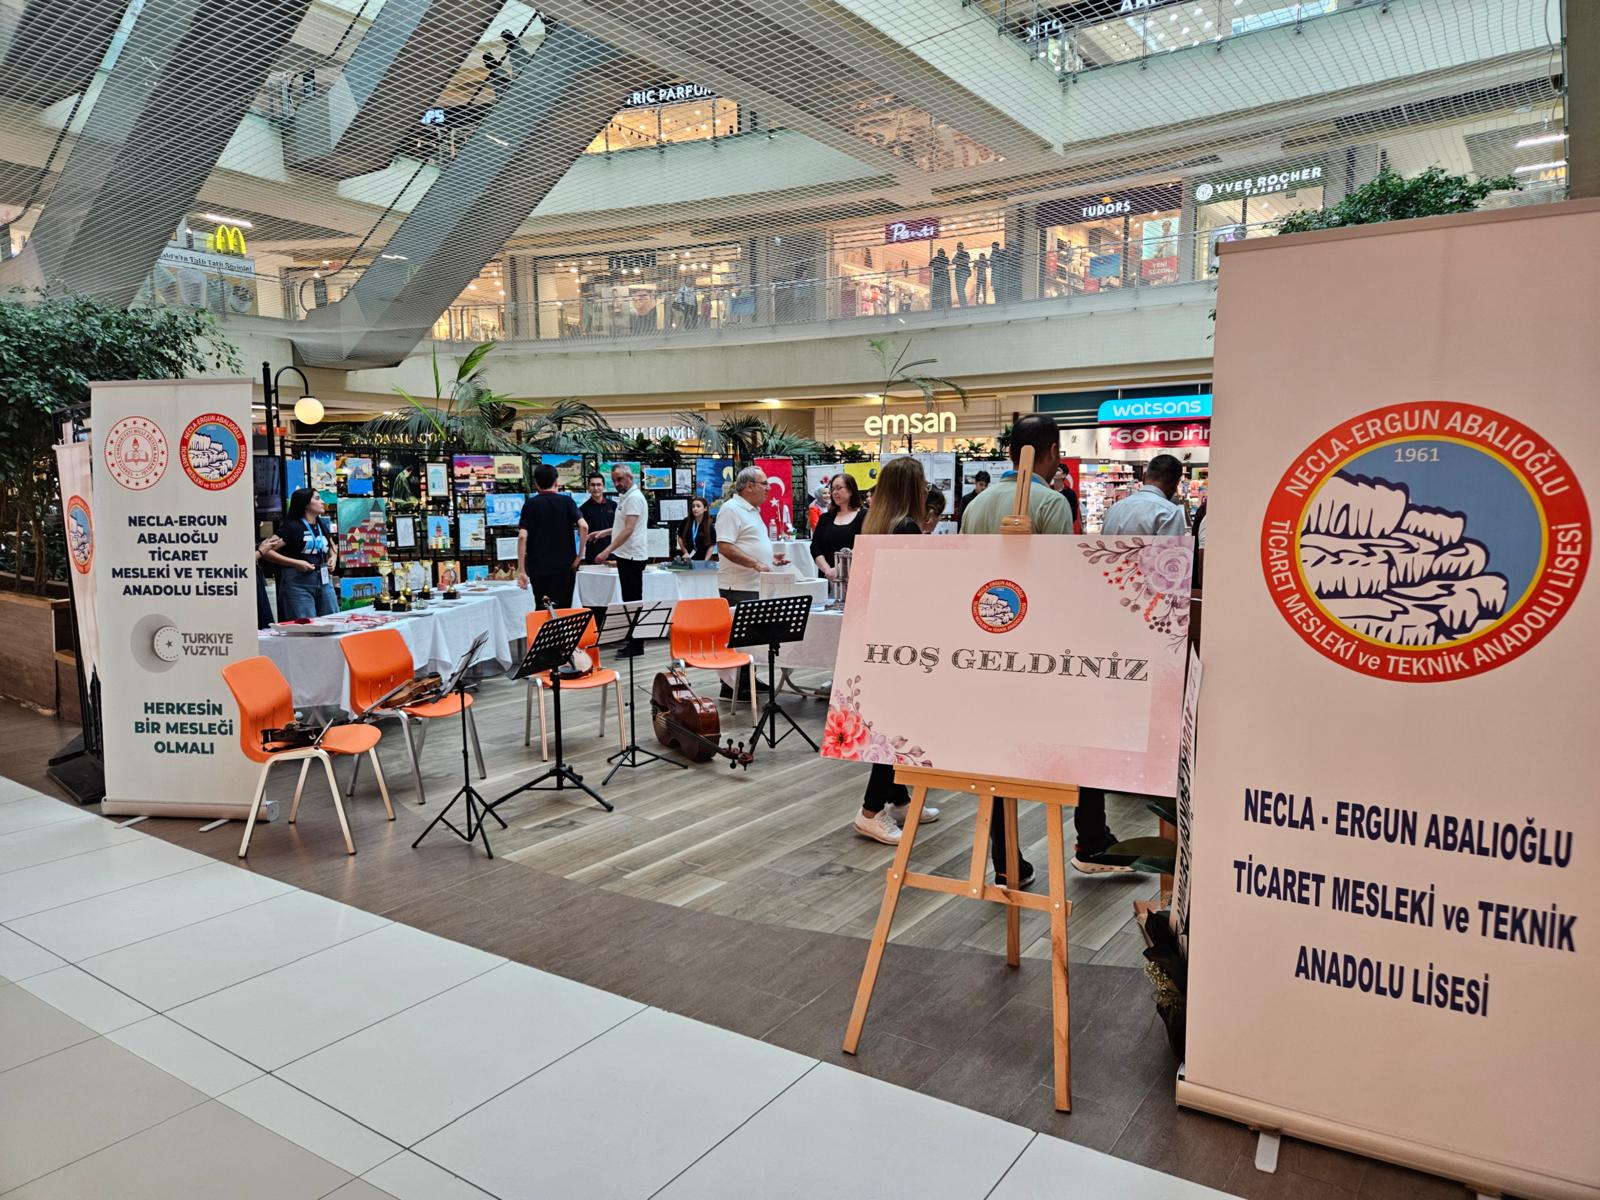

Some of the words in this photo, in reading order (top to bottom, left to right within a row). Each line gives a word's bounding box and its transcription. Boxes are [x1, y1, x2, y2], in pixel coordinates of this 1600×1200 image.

[1215, 179, 1253, 194] YVES
[1257, 167, 1322, 188] ROCHER
[1081, 200, 1132, 218] TUDORS
[890, 223, 935, 242] Penti
[1112, 400, 1201, 417] watsons
[864, 411, 957, 436] emsan
[1285, 408, 1441, 499] NECLA-ERGUN
[1443, 409, 1570, 497] ABALIOĞLU
[1393, 447, 1441, 464] 1961
[128, 515, 227, 527] NECLA-ERGUN
[137, 530, 218, 544] ABALIOĞLU
[148, 546, 208, 561] TİCARET
[112, 564, 170, 579] MESLEKİ
[174, 568, 192, 579] VE
[196, 564, 248, 579] TEKNİK
[122, 585, 191, 596] ANADOLU
[196, 581, 238, 596] LİSESİ
[1268, 519, 1298, 594] TİCARET
[1283, 594, 1359, 660] MESLEKİ
[1357, 653, 1381, 671] ve
[1385, 650, 1472, 676] TEKNİK
[1473, 594, 1565, 667] ANADOLU
[1548, 521, 1583, 590] LİSESİ
[864, 643, 940, 674] HOŞ
[951, 648, 1149, 682] GELDİNİZ
[144, 699, 223, 715] HERKESİN
[134, 717, 161, 734] BİR
[165, 719, 234, 735] MESLEĞİ
[154, 741, 215, 755] OLMALI
[1244, 788, 1316, 832] NECLA
[1335, 801, 1418, 847] ERGUN
[1424, 814, 1574, 869] ABALIOĞLU
[1233, 854, 1327, 908] TİCARET
[1331, 876, 1436, 928] MESLEKİ
[1442, 903, 1470, 934] ve
[1477, 900, 1578, 953] TEKNİK
[1294, 945, 1405, 1000] ANADOLU
[1411, 962, 1490, 1018] LİSESİ
